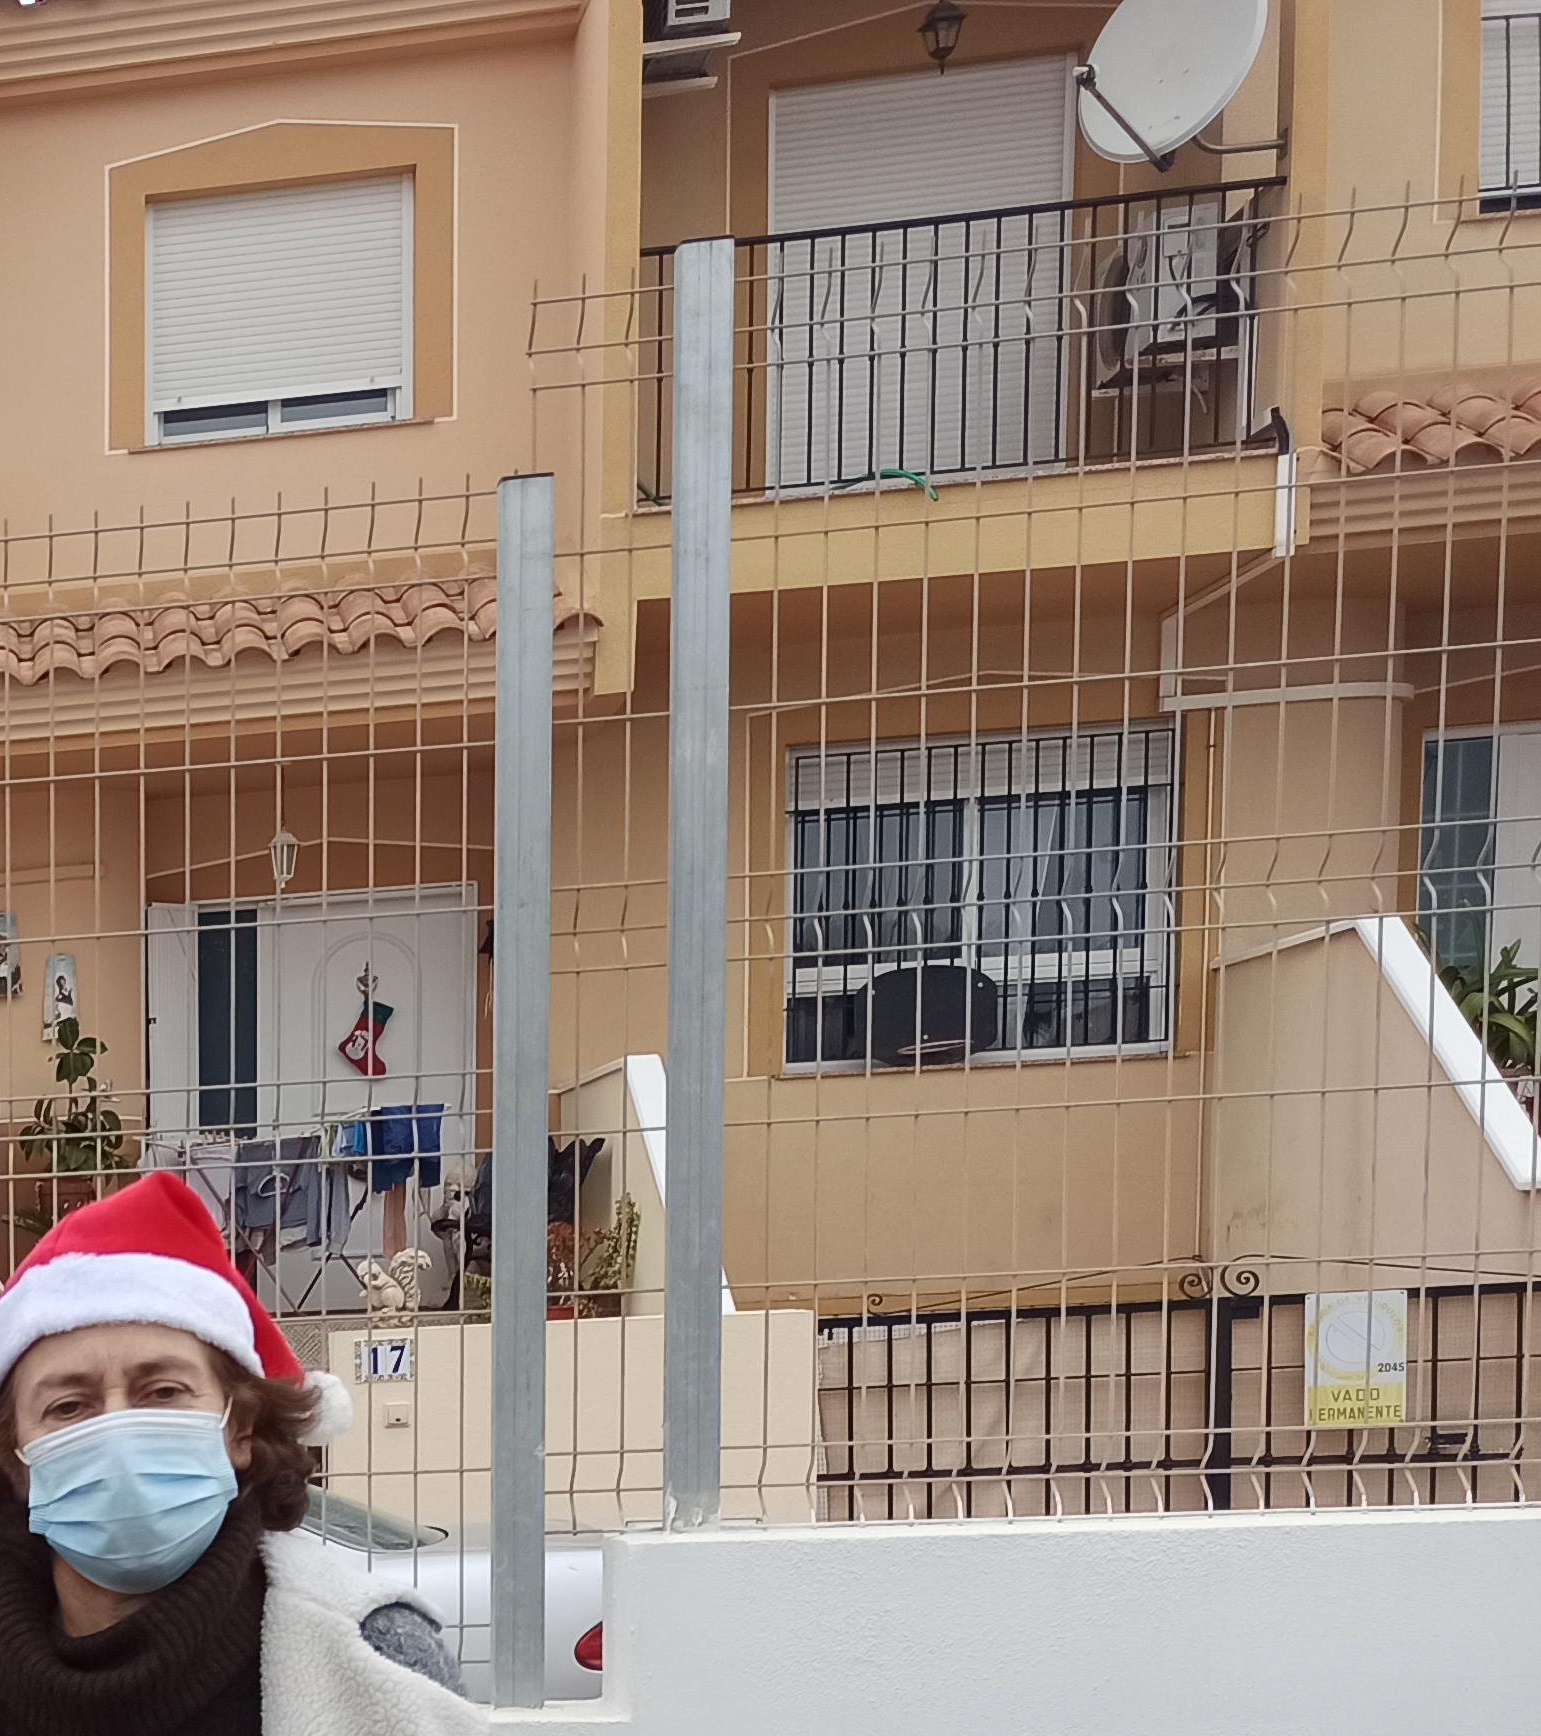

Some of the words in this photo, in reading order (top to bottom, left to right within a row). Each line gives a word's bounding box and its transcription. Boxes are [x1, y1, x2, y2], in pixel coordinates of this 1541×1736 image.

[371, 1344, 406, 1375] 17
[1377, 1361, 1405, 1373] 2045
[1330, 1388, 1381, 1403] VADO
